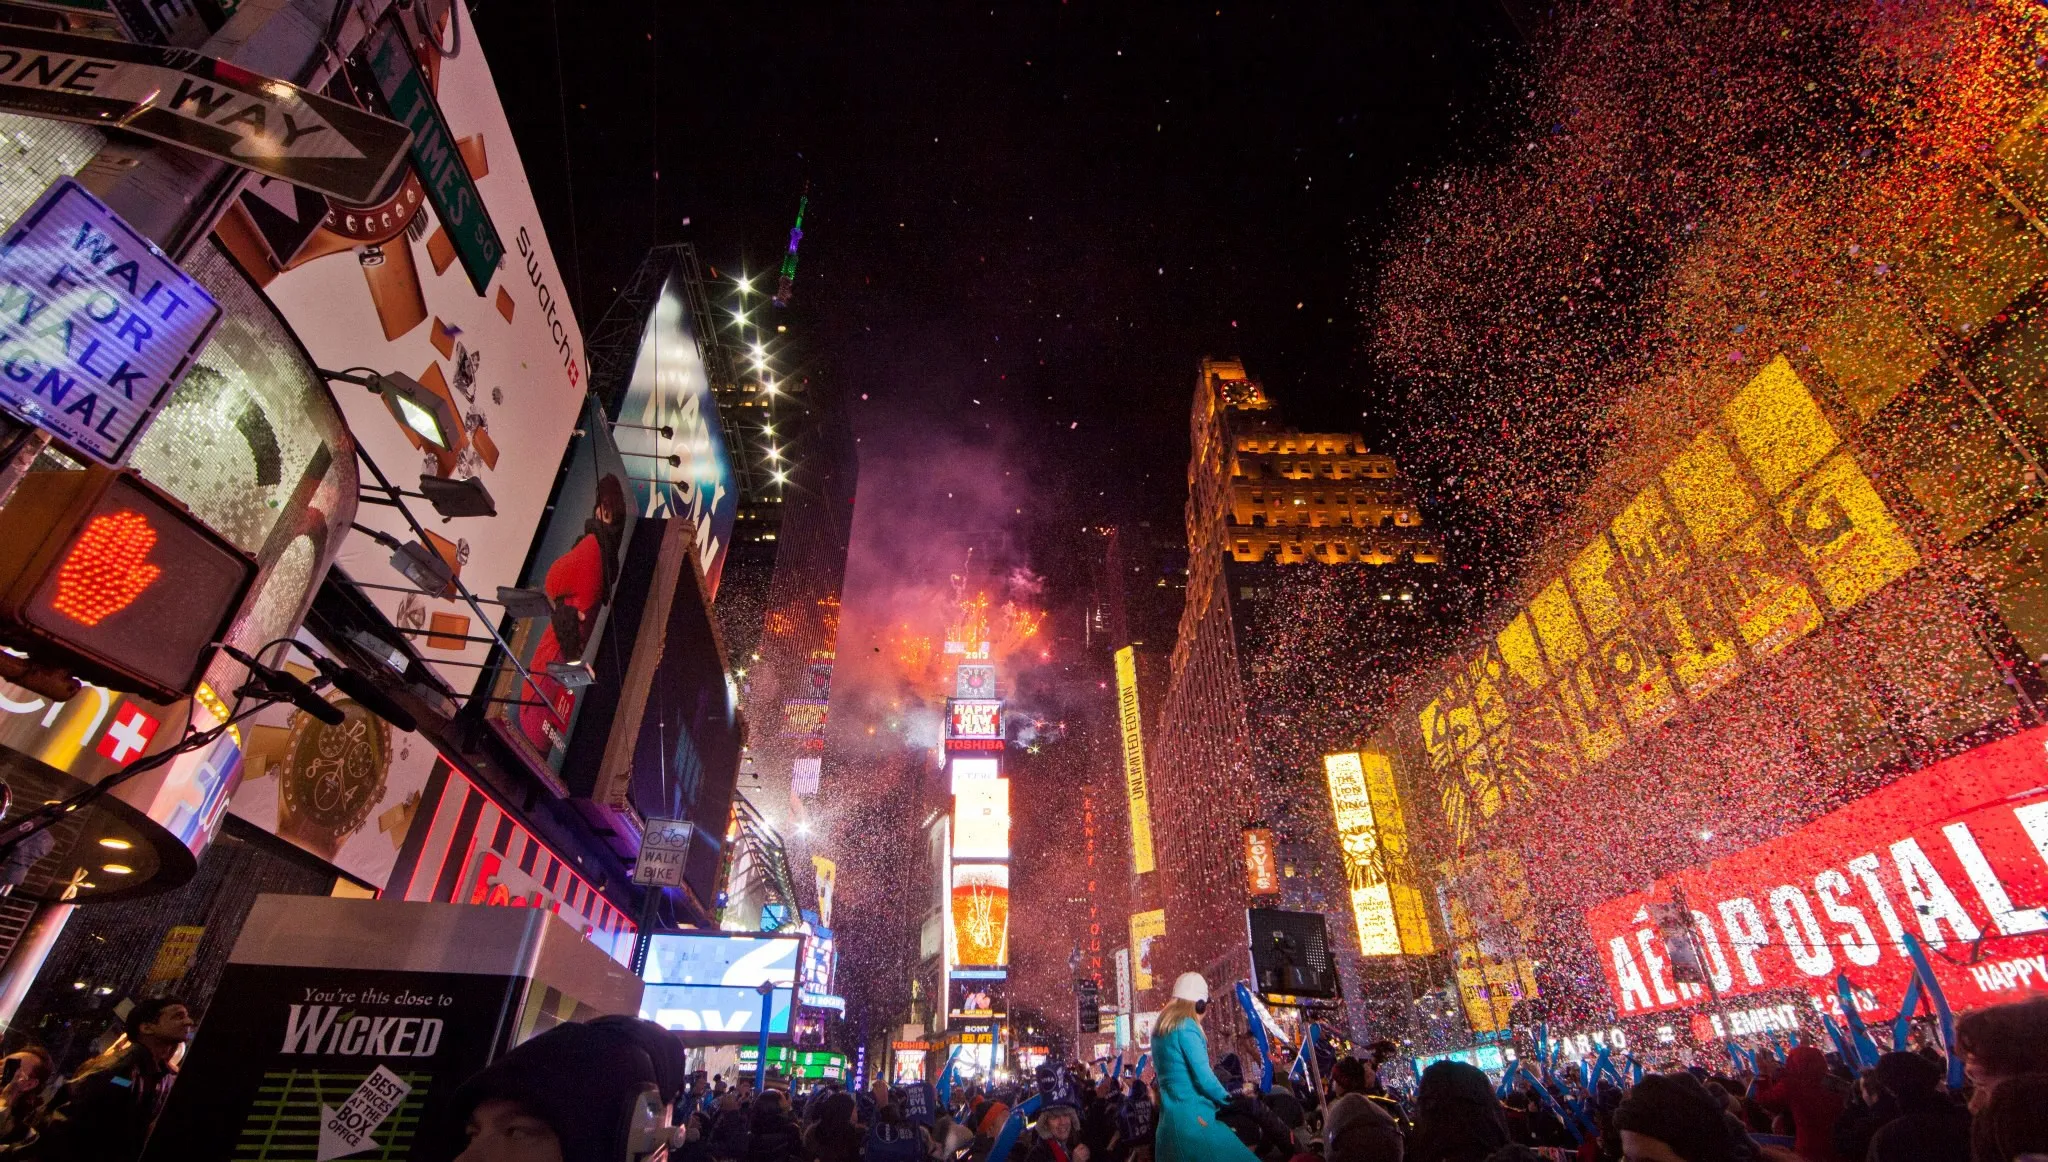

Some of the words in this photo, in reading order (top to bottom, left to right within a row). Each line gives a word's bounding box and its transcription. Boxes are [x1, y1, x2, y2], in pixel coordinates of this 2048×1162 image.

[168, 78, 327, 149] WAY
[403, 88, 470, 226] TIMES
[72, 221, 189, 320] WAIT
[48, 263, 153, 352] FOR
[516, 226, 573, 367] swatch
[0, 332, 118, 443] GNAL
[954, 704, 999, 715] HAPPY
[961, 714, 992, 724] NEW
[1122, 686, 1137, 730] EDITION
[947, 740, 1005, 750] TOSHIBA
[1128, 732, 1145, 799] UNLIMITED
[1336, 775, 1355, 784] THE
[1335, 785, 1361, 797] LION
[1335, 799, 1367, 813] KING
[644, 851, 679, 864] WALK
[644, 867, 675, 880] BIKE
[1609, 801, 2048, 1011] AÉOPOSTAL
[1968, 955, 2048, 992] HAPPY
[304, 987, 356, 1003] You're
[360, 988, 390, 1004] this
[394, 990, 433, 1005] close
[438, 994, 453, 1006] to
[1826, 988, 1880, 1015] 213!
[1711, 1004, 1798, 1037] EEMENT
[892, 1041, 930, 1050] TOSHIBA
[358, 1086, 392, 1113] PRICES
[367, 1071, 404, 1102] BEST
[336, 1105, 374, 1137] BOX
[348, 1096, 365, 1110] AT
[364, 1103, 383, 1123] THE
[327, 1119, 361, 1147] OFFICE
